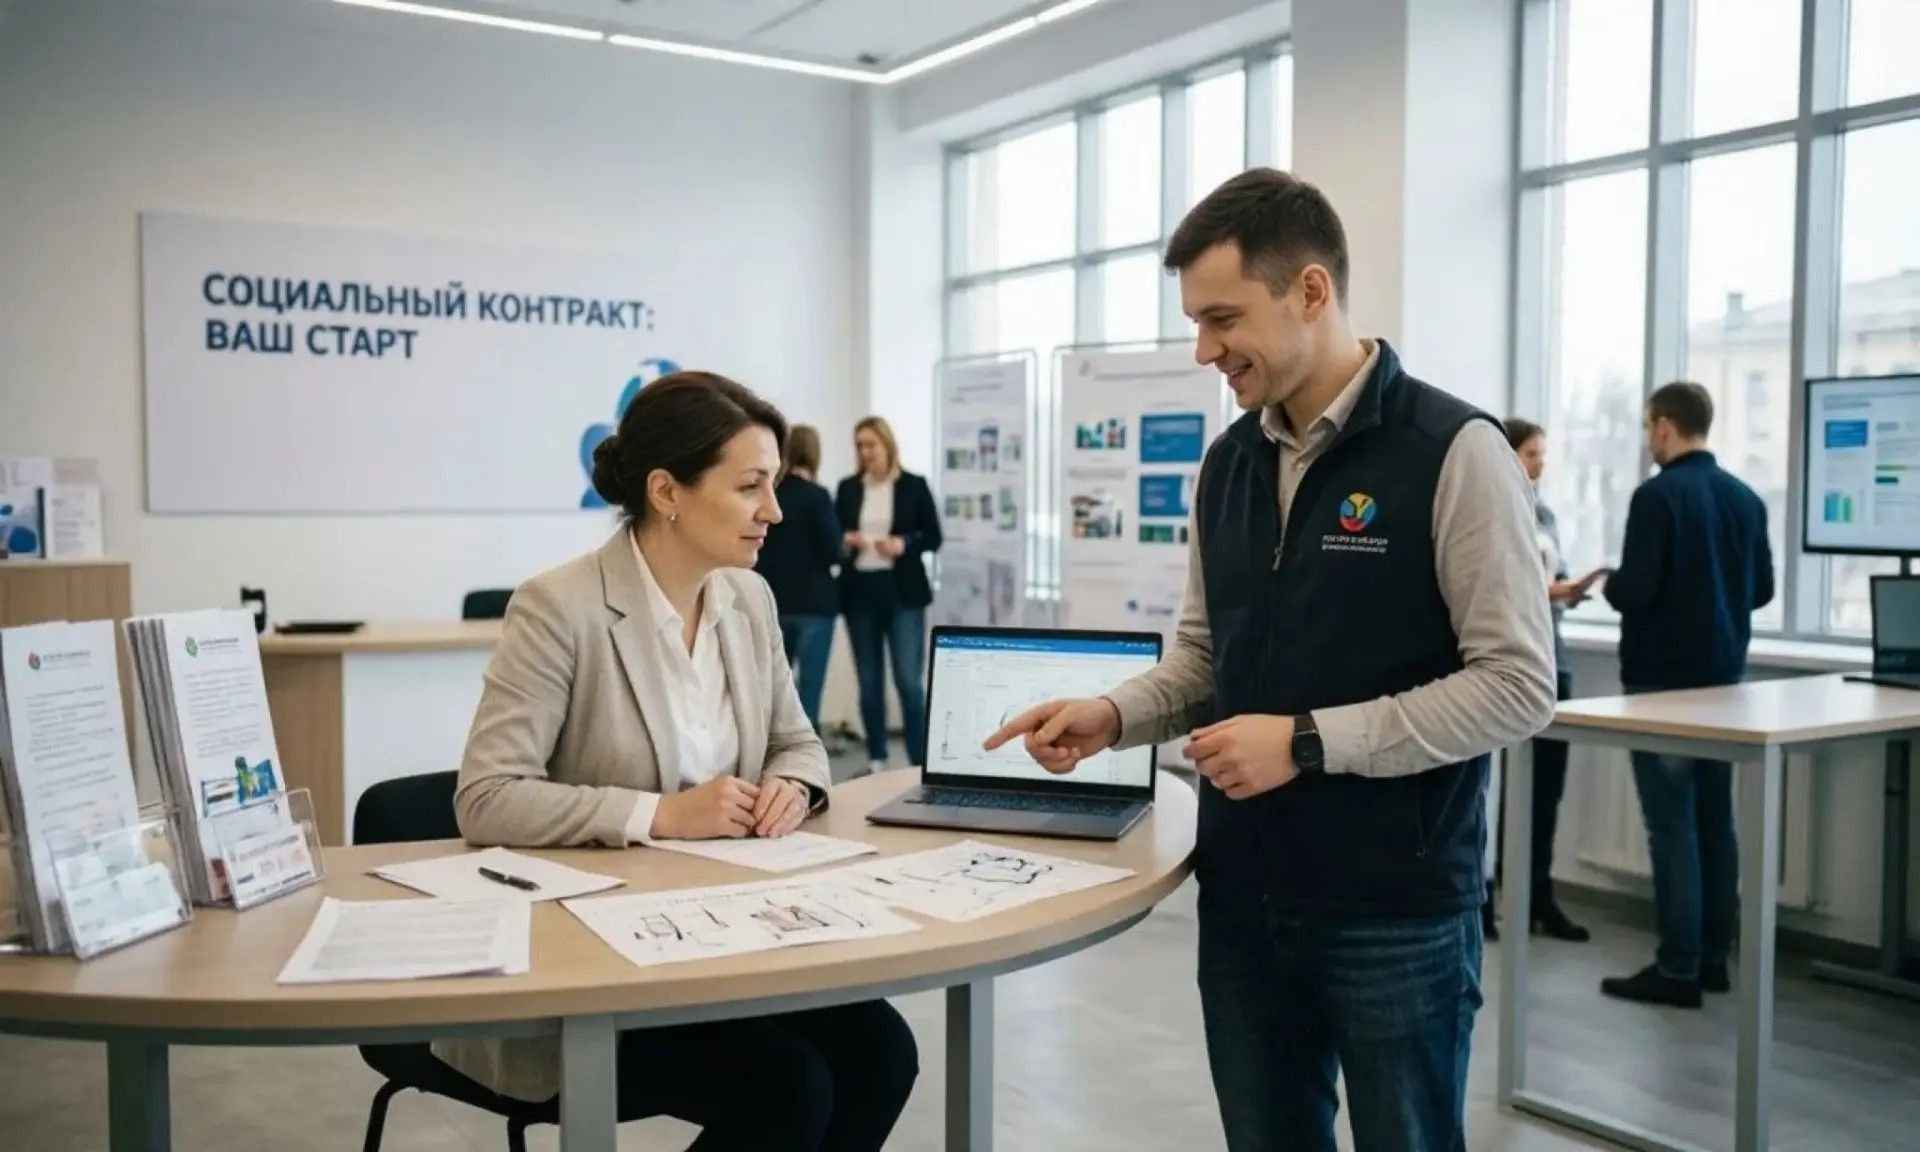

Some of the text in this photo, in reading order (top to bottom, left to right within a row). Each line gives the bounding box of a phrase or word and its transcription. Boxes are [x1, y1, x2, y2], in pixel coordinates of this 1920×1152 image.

[202, 272, 655, 330] СОЦИАЛЬНЫЙ КОНТРАКТ:
[205, 319, 419, 359] ВАШ СТАРТ
